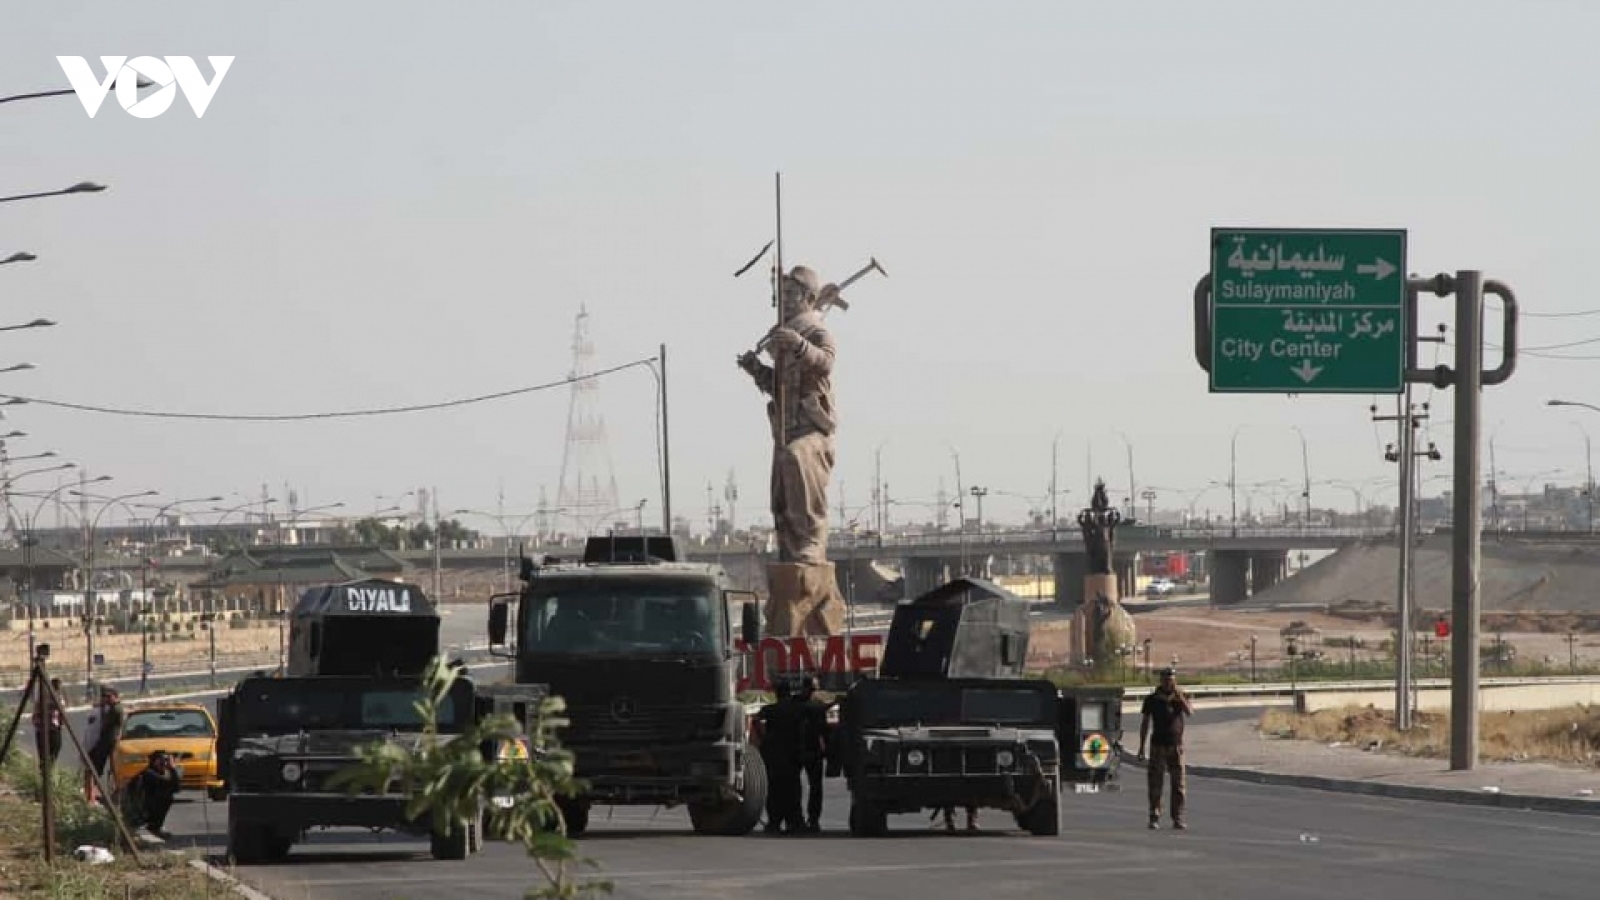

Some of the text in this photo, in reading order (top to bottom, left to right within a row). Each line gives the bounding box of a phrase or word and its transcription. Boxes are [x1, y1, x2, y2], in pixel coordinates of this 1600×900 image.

[1227, 235, 1346, 279] سليمانية
[1221, 280, 1356, 304] Sulaymaniyah
[1281, 309, 1395, 340] مركز المدينة
[1221, 337, 1343, 361] City Center
[347, 586, 412, 613] DIYALA
